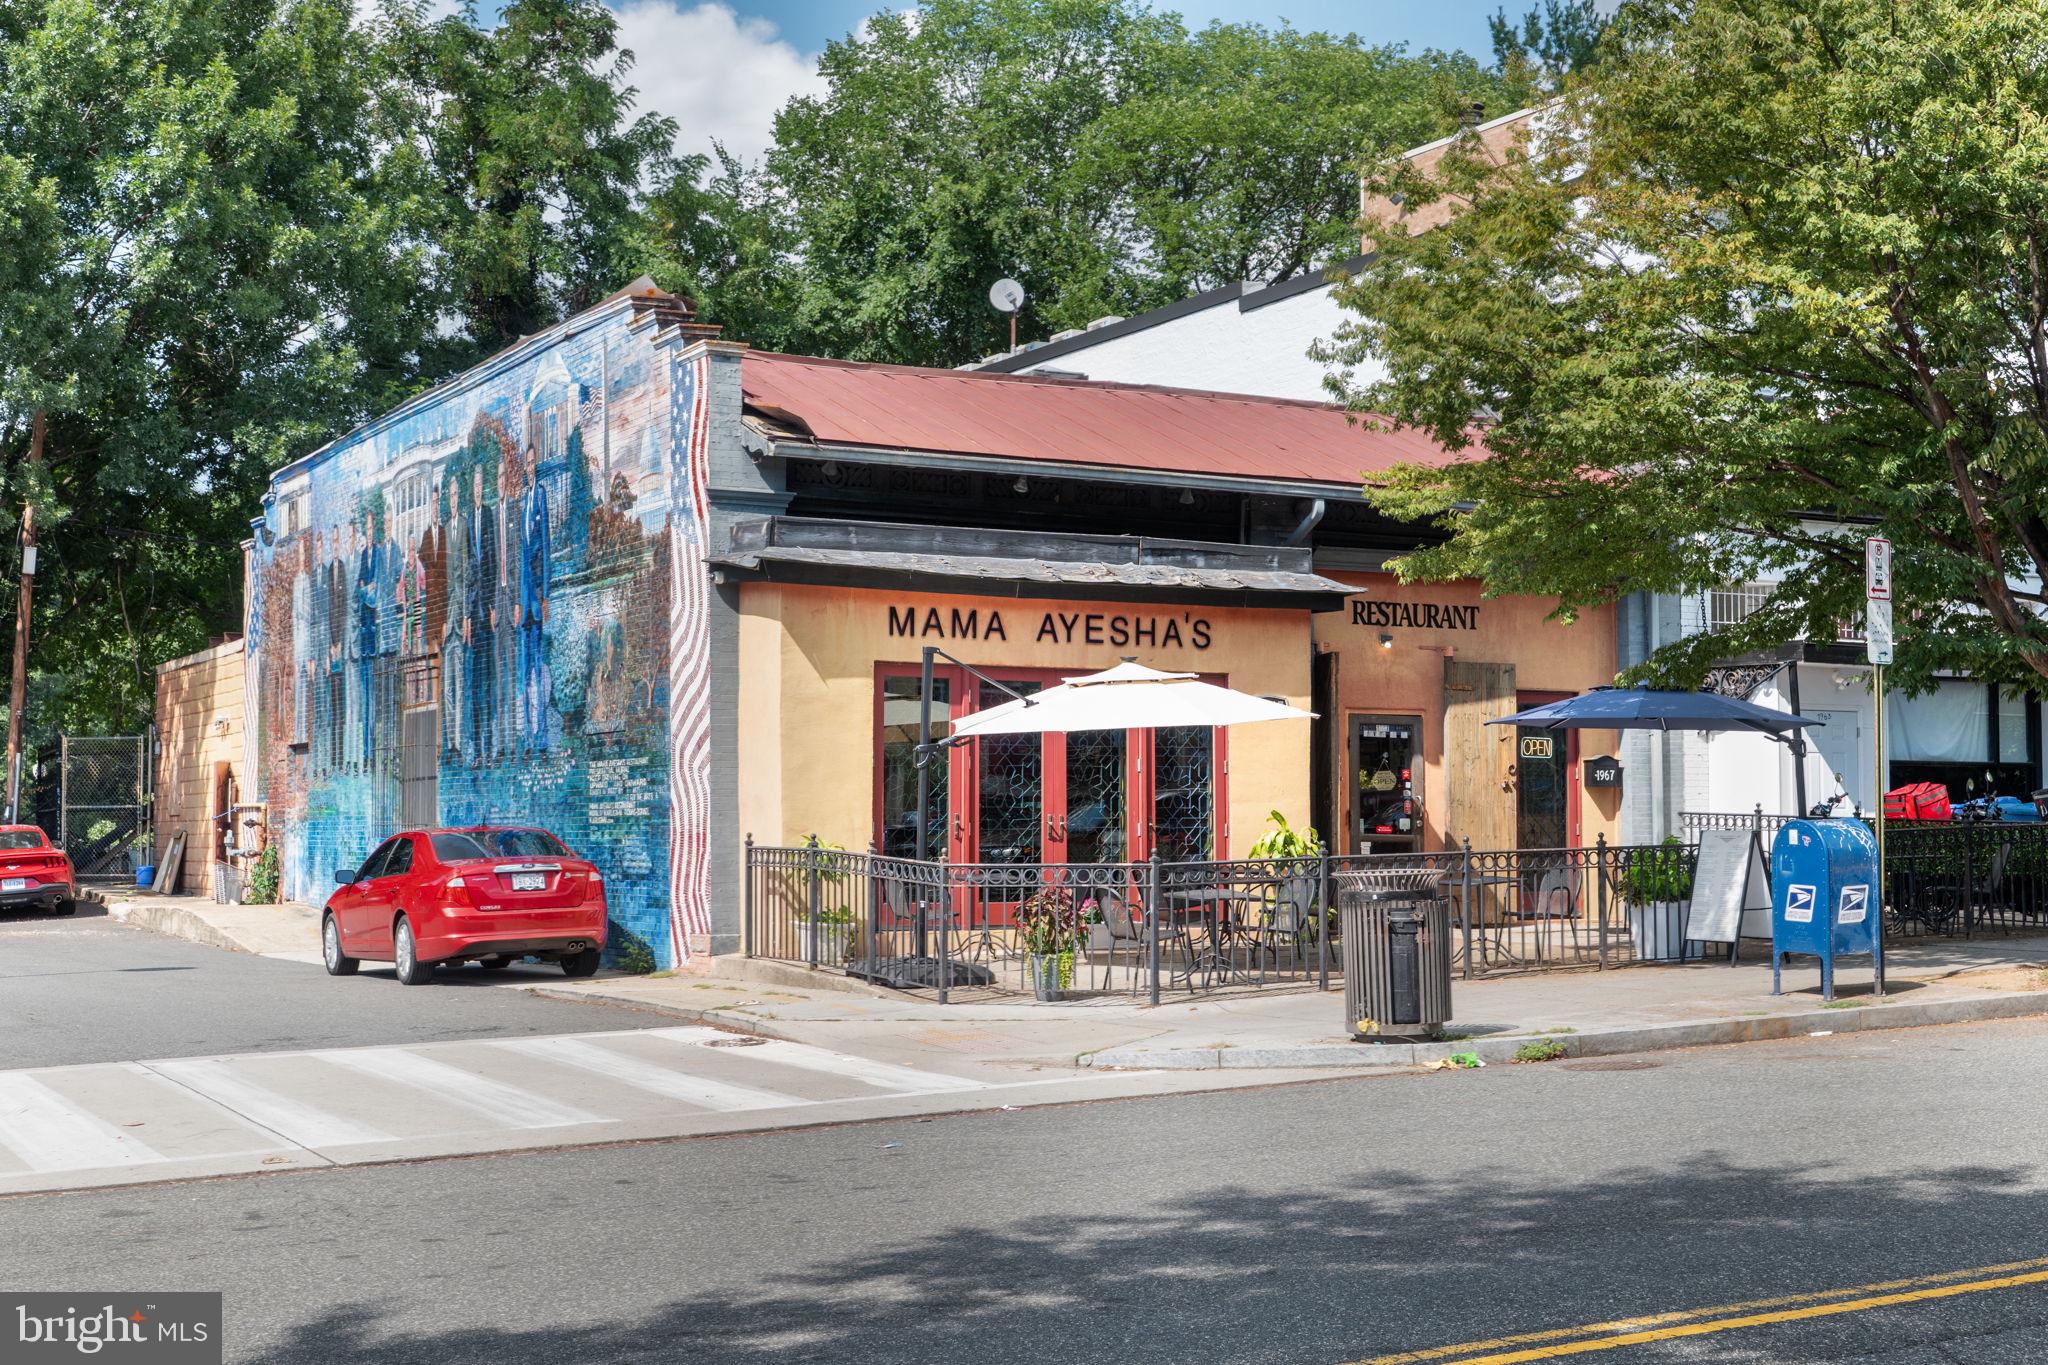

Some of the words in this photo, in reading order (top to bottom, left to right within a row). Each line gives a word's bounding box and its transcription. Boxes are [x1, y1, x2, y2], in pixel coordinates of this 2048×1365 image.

[1351, 600, 1480, 630] RESTAURANT
[889, 605, 1007, 642] MAMA
[1035, 611, 1212, 649] AYESHA'S
[1523, 739, 1551, 756] OPEN
[1596, 769, 1616, 781] 1967
